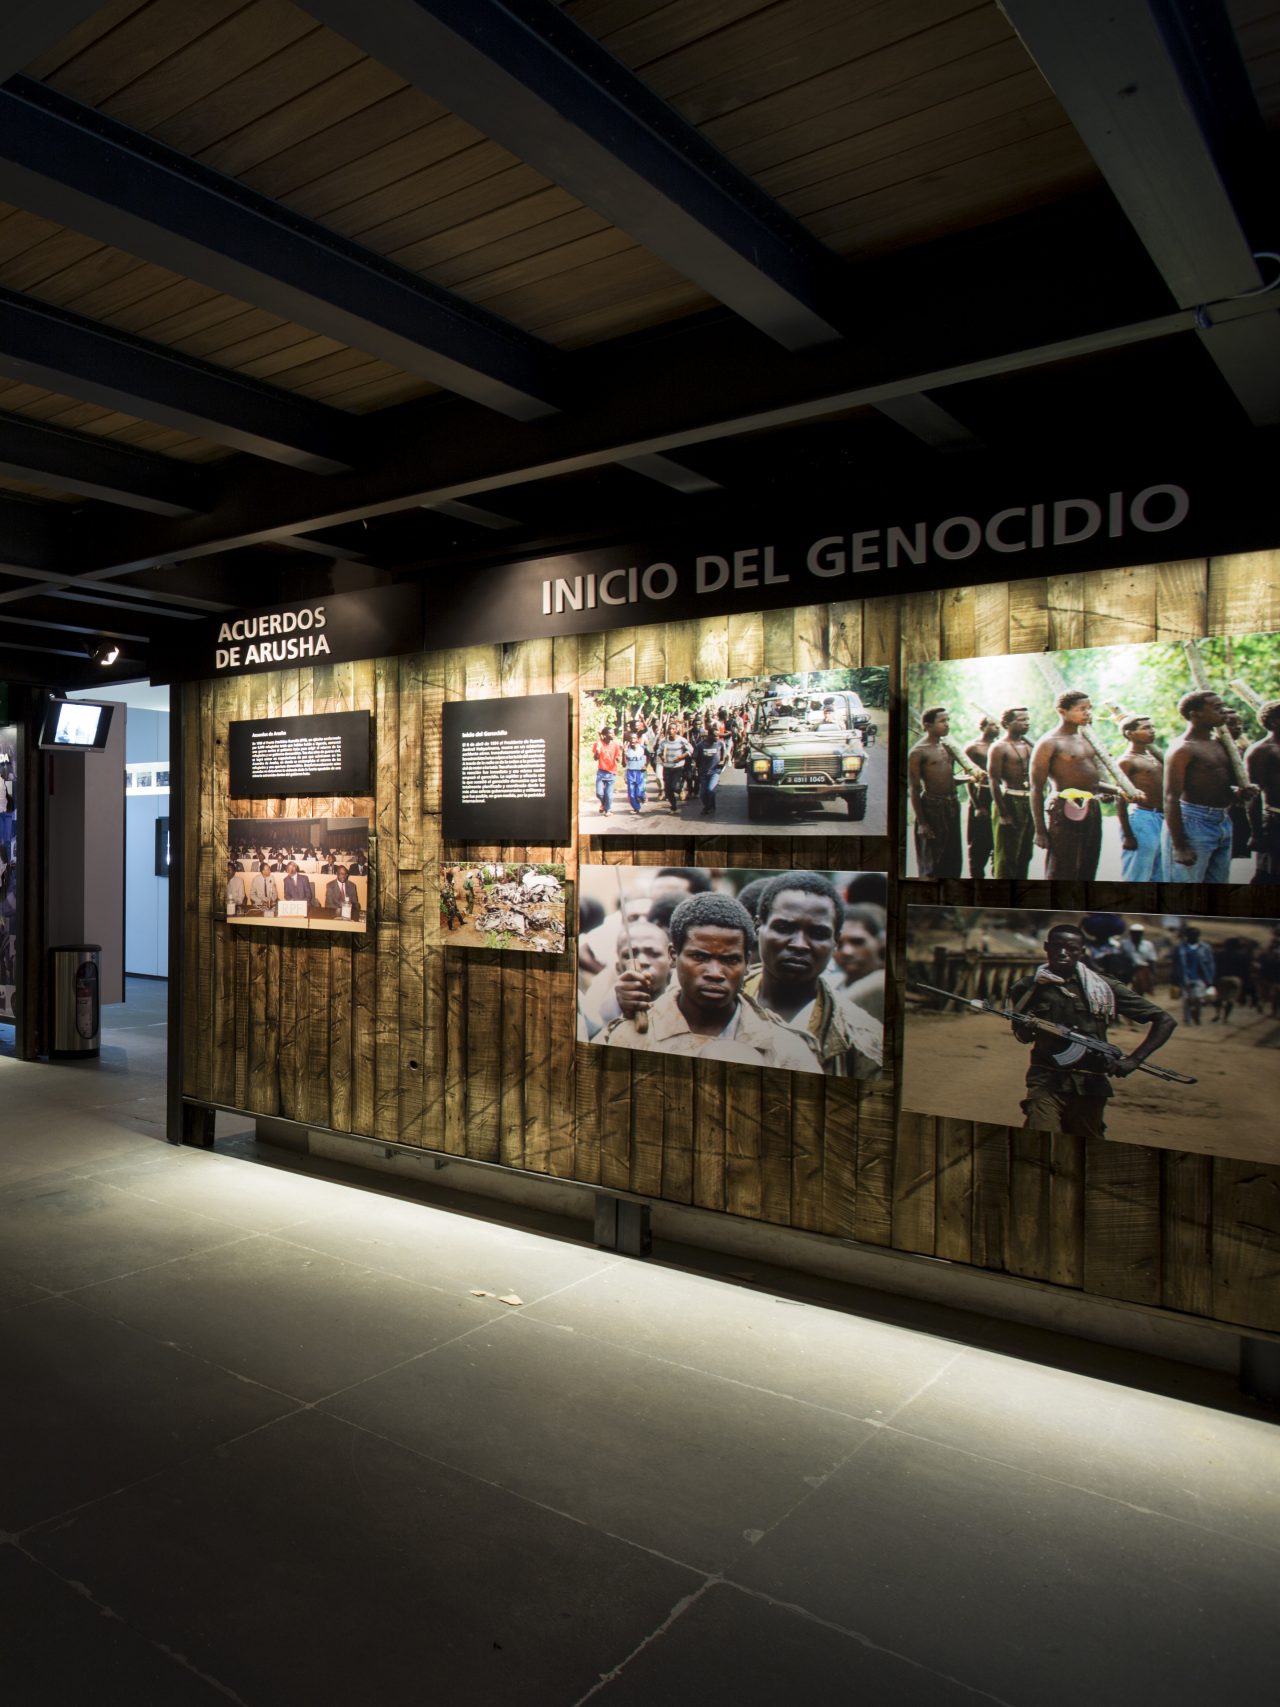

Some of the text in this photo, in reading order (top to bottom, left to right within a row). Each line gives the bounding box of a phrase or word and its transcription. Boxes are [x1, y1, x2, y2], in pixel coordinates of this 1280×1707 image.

[542, 483, 1190, 614] INICIO DEL GENOCIDIO
[218, 607, 327, 642] ACUERDOS
[216, 635, 331, 669] DE ARUSHA
